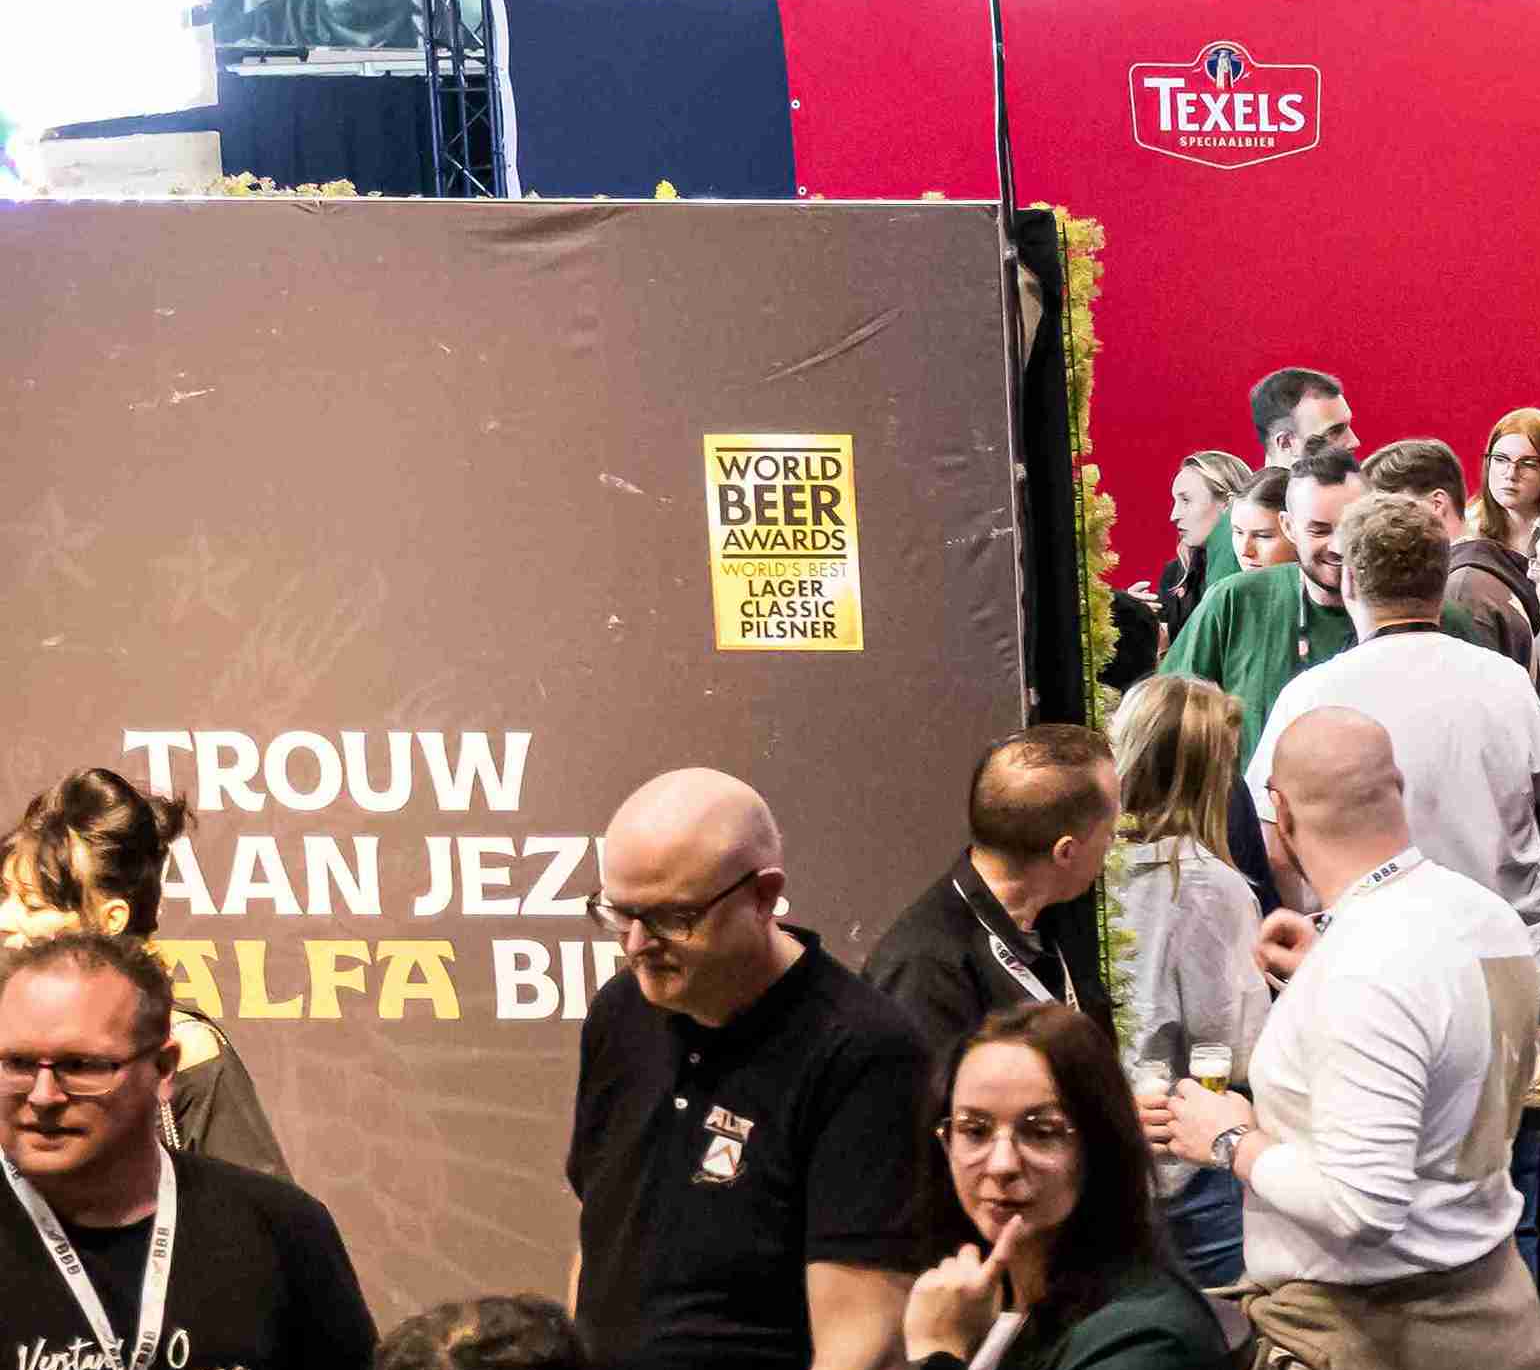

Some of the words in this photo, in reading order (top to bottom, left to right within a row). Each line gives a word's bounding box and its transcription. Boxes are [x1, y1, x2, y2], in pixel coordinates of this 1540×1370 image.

[1179, 135, 1276, 148] SPECIAALBIER
[716, 455, 842, 481] WORLD
[718, 484, 846, 527] BEER
[722, 529, 847, 551] AWARDS
[722, 562, 801, 577] WORLD'S
[808, 562, 848, 577] BEST
[749, 580, 824, 598] LAGER
[740, 600, 836, 619] CLASSIC
[741, 620, 837, 639] PILSNER
[122, 729, 532, 812] TROUW
[158, 835, 382, 916] AAN
[414, 835, 608, 917] JEZ
[1371, 862, 1400, 883] BBB
[155, 939, 461, 1020] ALFA
